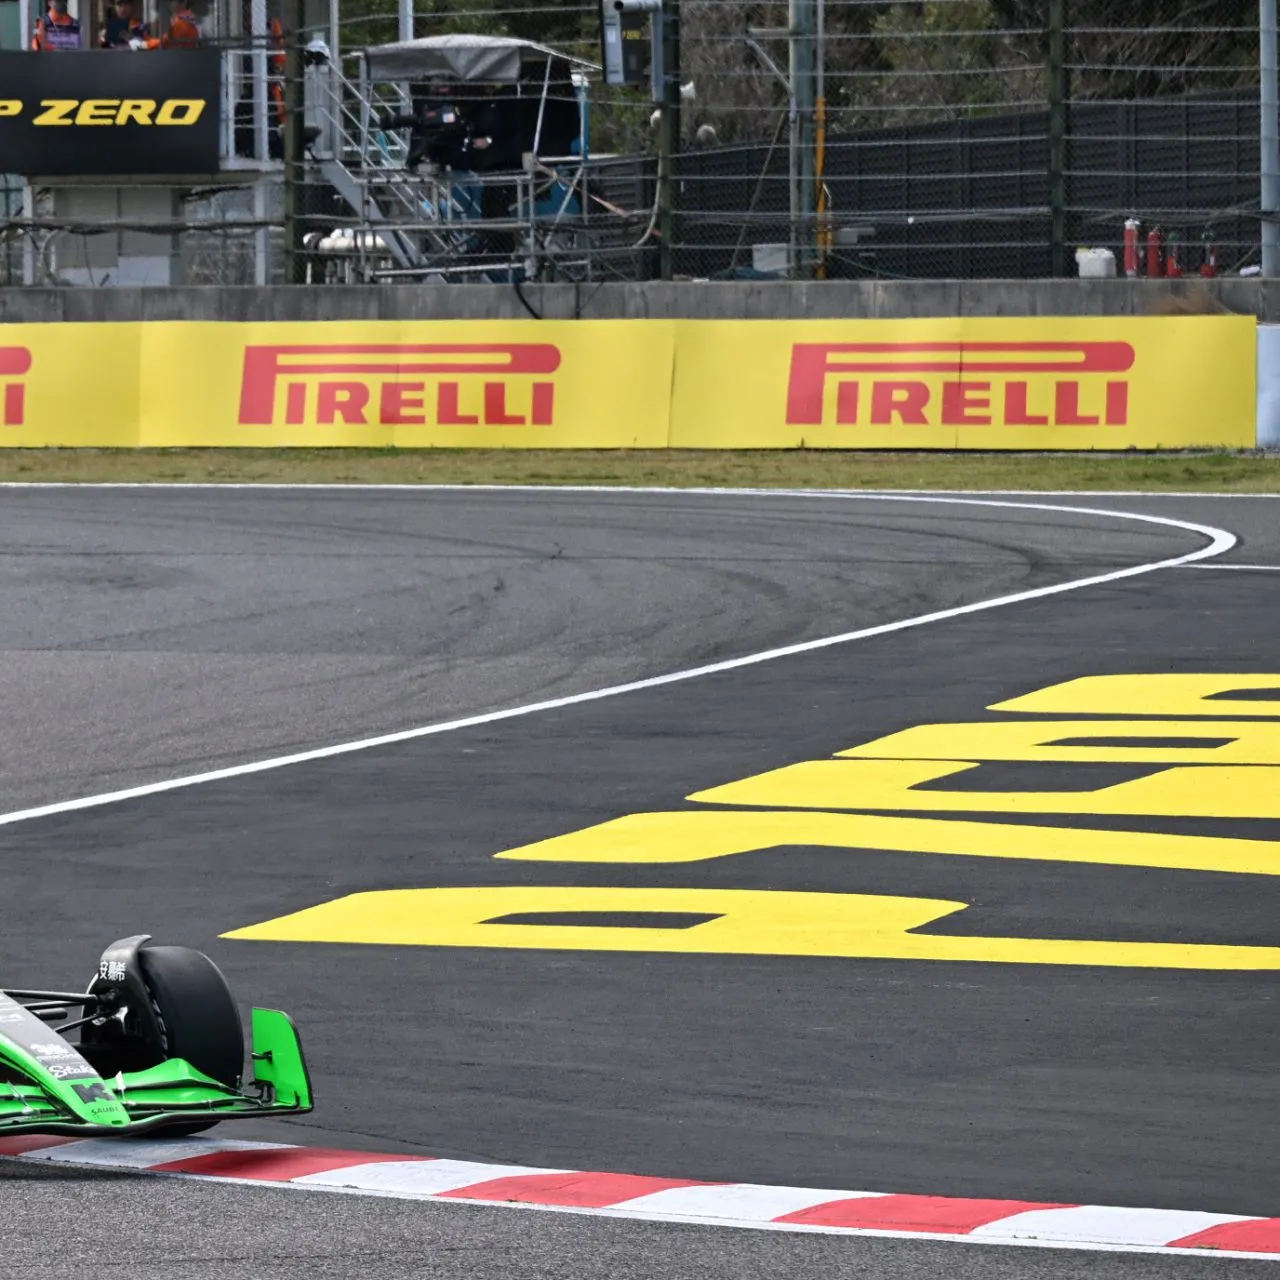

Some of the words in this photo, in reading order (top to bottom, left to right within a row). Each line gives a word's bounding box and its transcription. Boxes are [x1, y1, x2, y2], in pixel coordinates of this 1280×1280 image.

[31, 99, 207, 127] ZERO
[239, 343, 562, 426] PIRELLI
[786, 341, 1136, 425] PIRELLI
